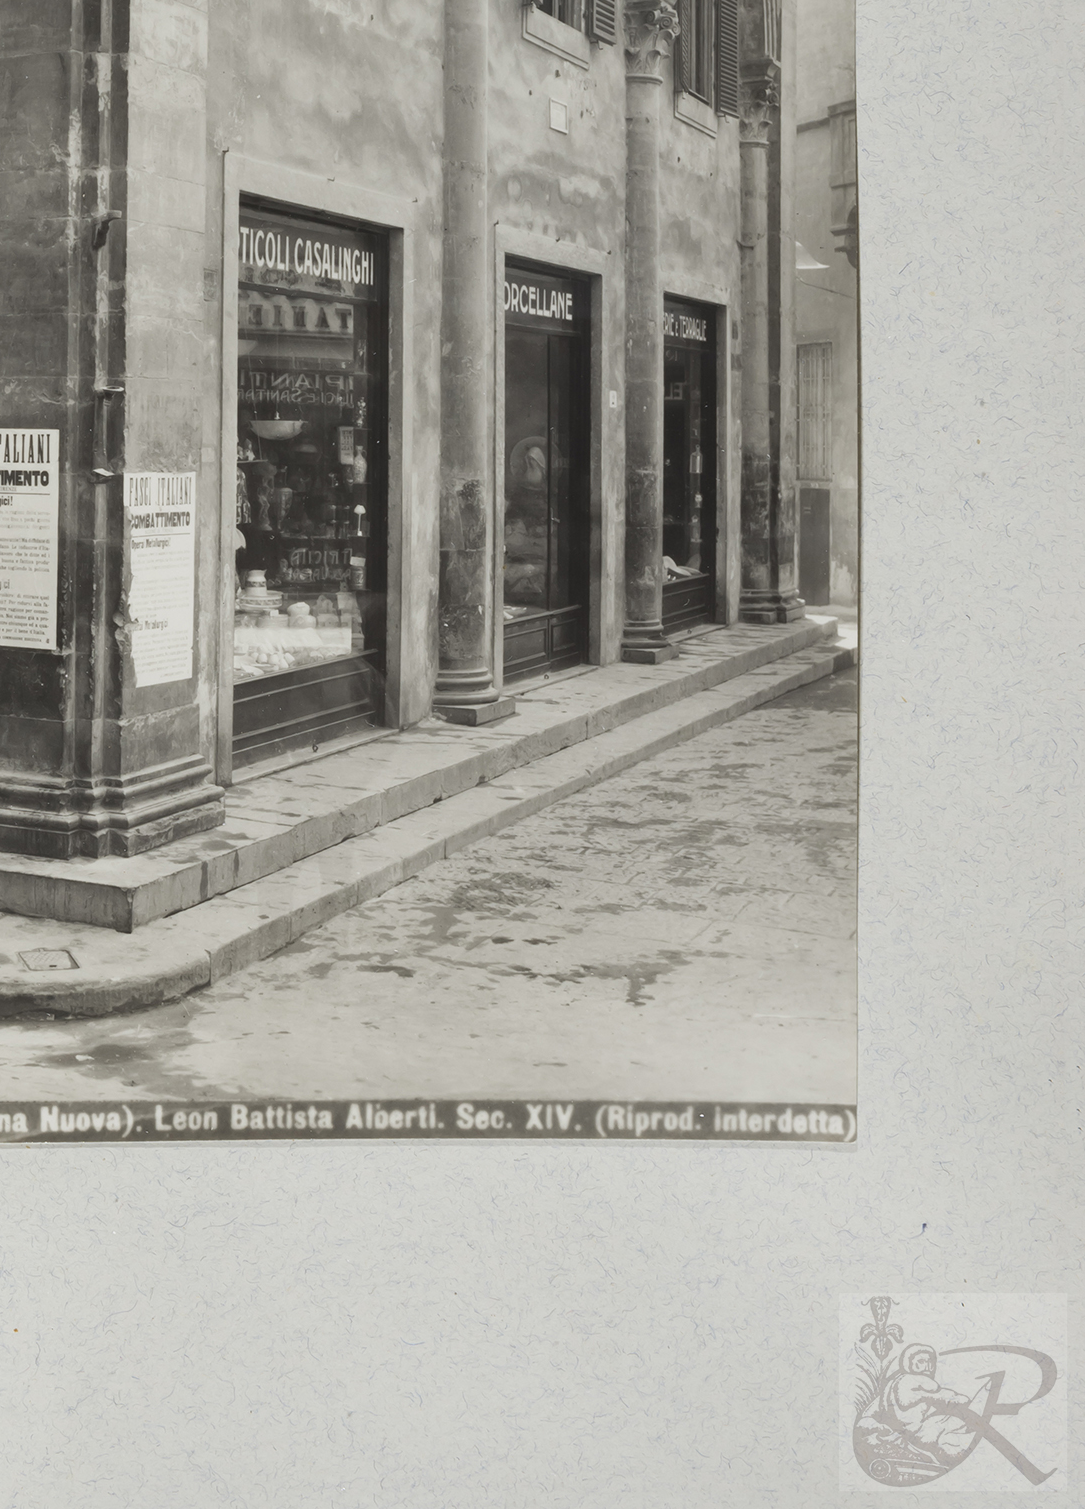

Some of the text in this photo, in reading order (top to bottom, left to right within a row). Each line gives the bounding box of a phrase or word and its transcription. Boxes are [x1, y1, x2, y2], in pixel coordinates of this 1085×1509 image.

[294, 237, 374, 286] CASALINGHI
[129, 477, 192, 507] FASCI ITALIANI
